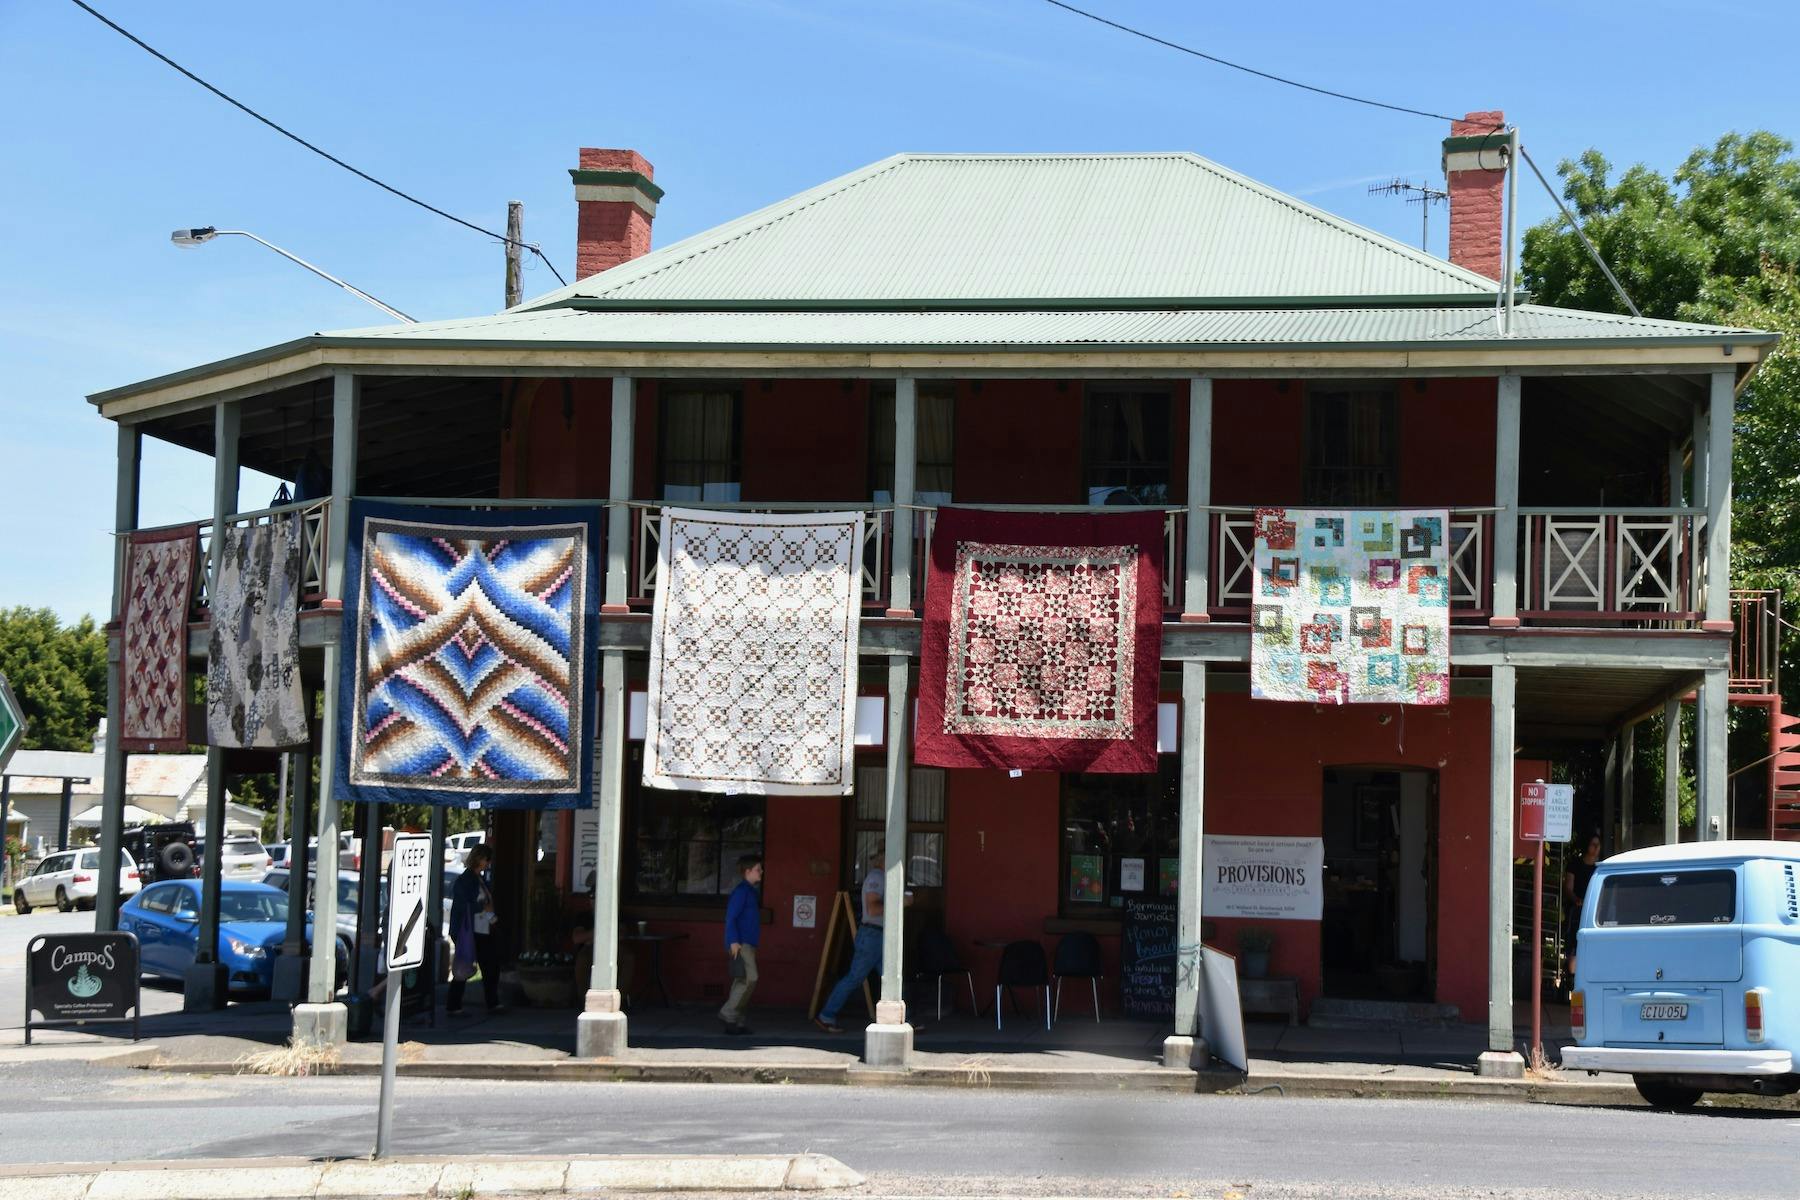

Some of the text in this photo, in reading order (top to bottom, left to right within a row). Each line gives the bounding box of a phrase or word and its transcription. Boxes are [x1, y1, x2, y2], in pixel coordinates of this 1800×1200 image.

[1528, 787, 1539, 796] NO
[1521, 797, 1545, 806] STOPPING
[401, 848, 426, 867] KEEP
[400, 874, 423, 894] LEFT
[1217, 865, 1306, 886] PROVISIONS
